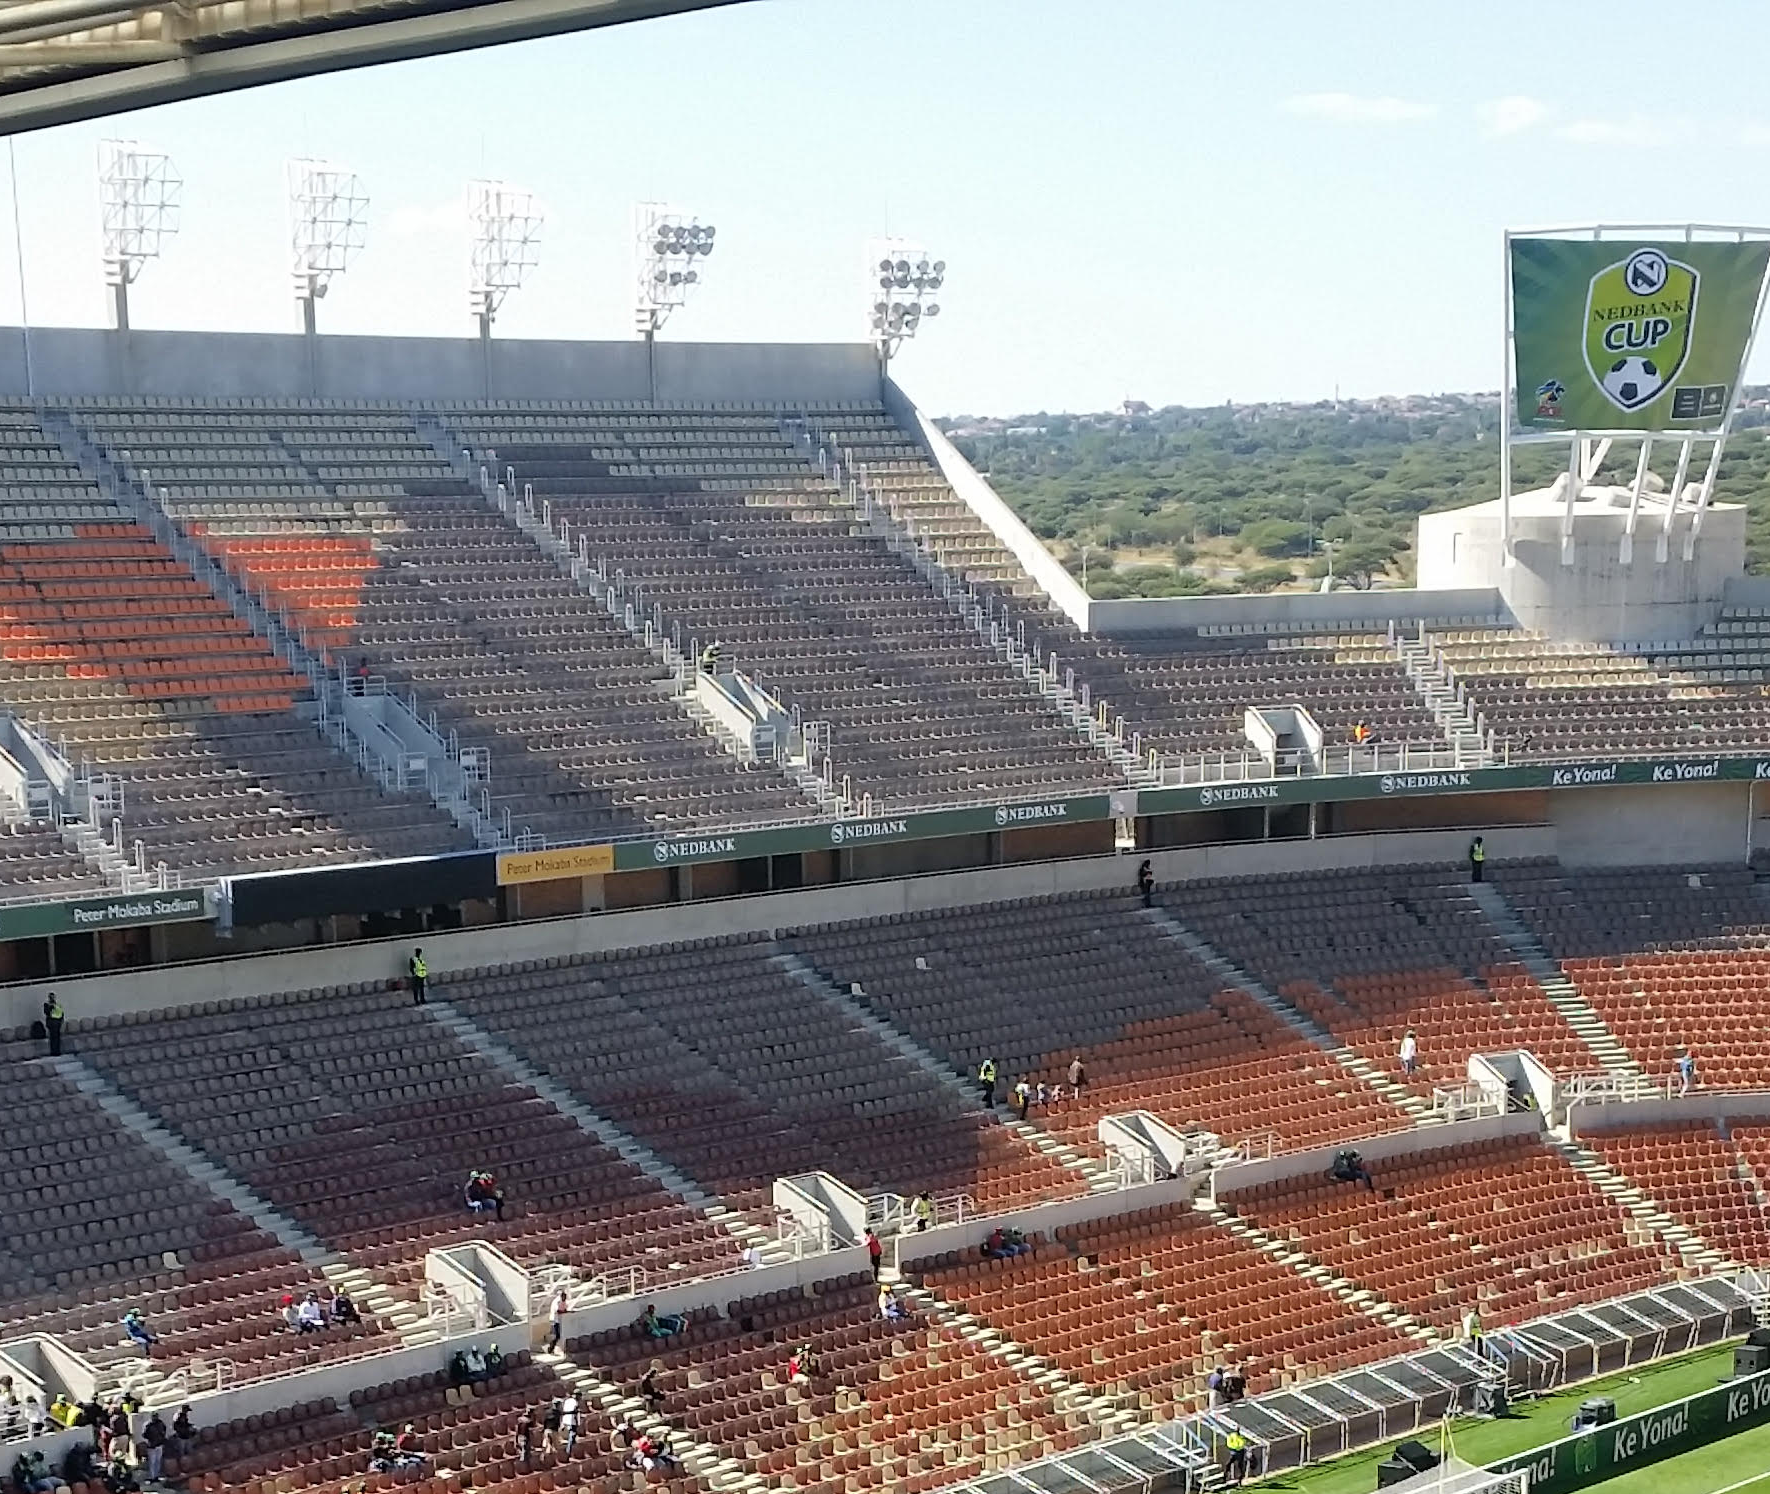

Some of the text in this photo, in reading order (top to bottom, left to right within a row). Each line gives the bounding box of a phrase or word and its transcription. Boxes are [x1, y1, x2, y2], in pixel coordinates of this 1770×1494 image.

[1593, 300, 1687, 322] NEDBANK
[1603, 317, 1671, 351] CUP
[1396, 773, 1470, 789] NEDBANK
[1553, 763, 1616, 785] Ke Yona!
[1653, 759, 1720, 782] Ke Yona!
[1213, 785, 1279, 802] NEDBANK
[1005, 803, 1067, 823] NEDBANK
[845, 821, 908, 840] NEDBANK
[670, 838, 736, 859] NEDBANK
[73, 898, 199, 923] Peter Mokaba Stadium
[1728, 1389, 1750, 1423] Ke
[1613, 1405, 1690, 1463] Ke Yona!
